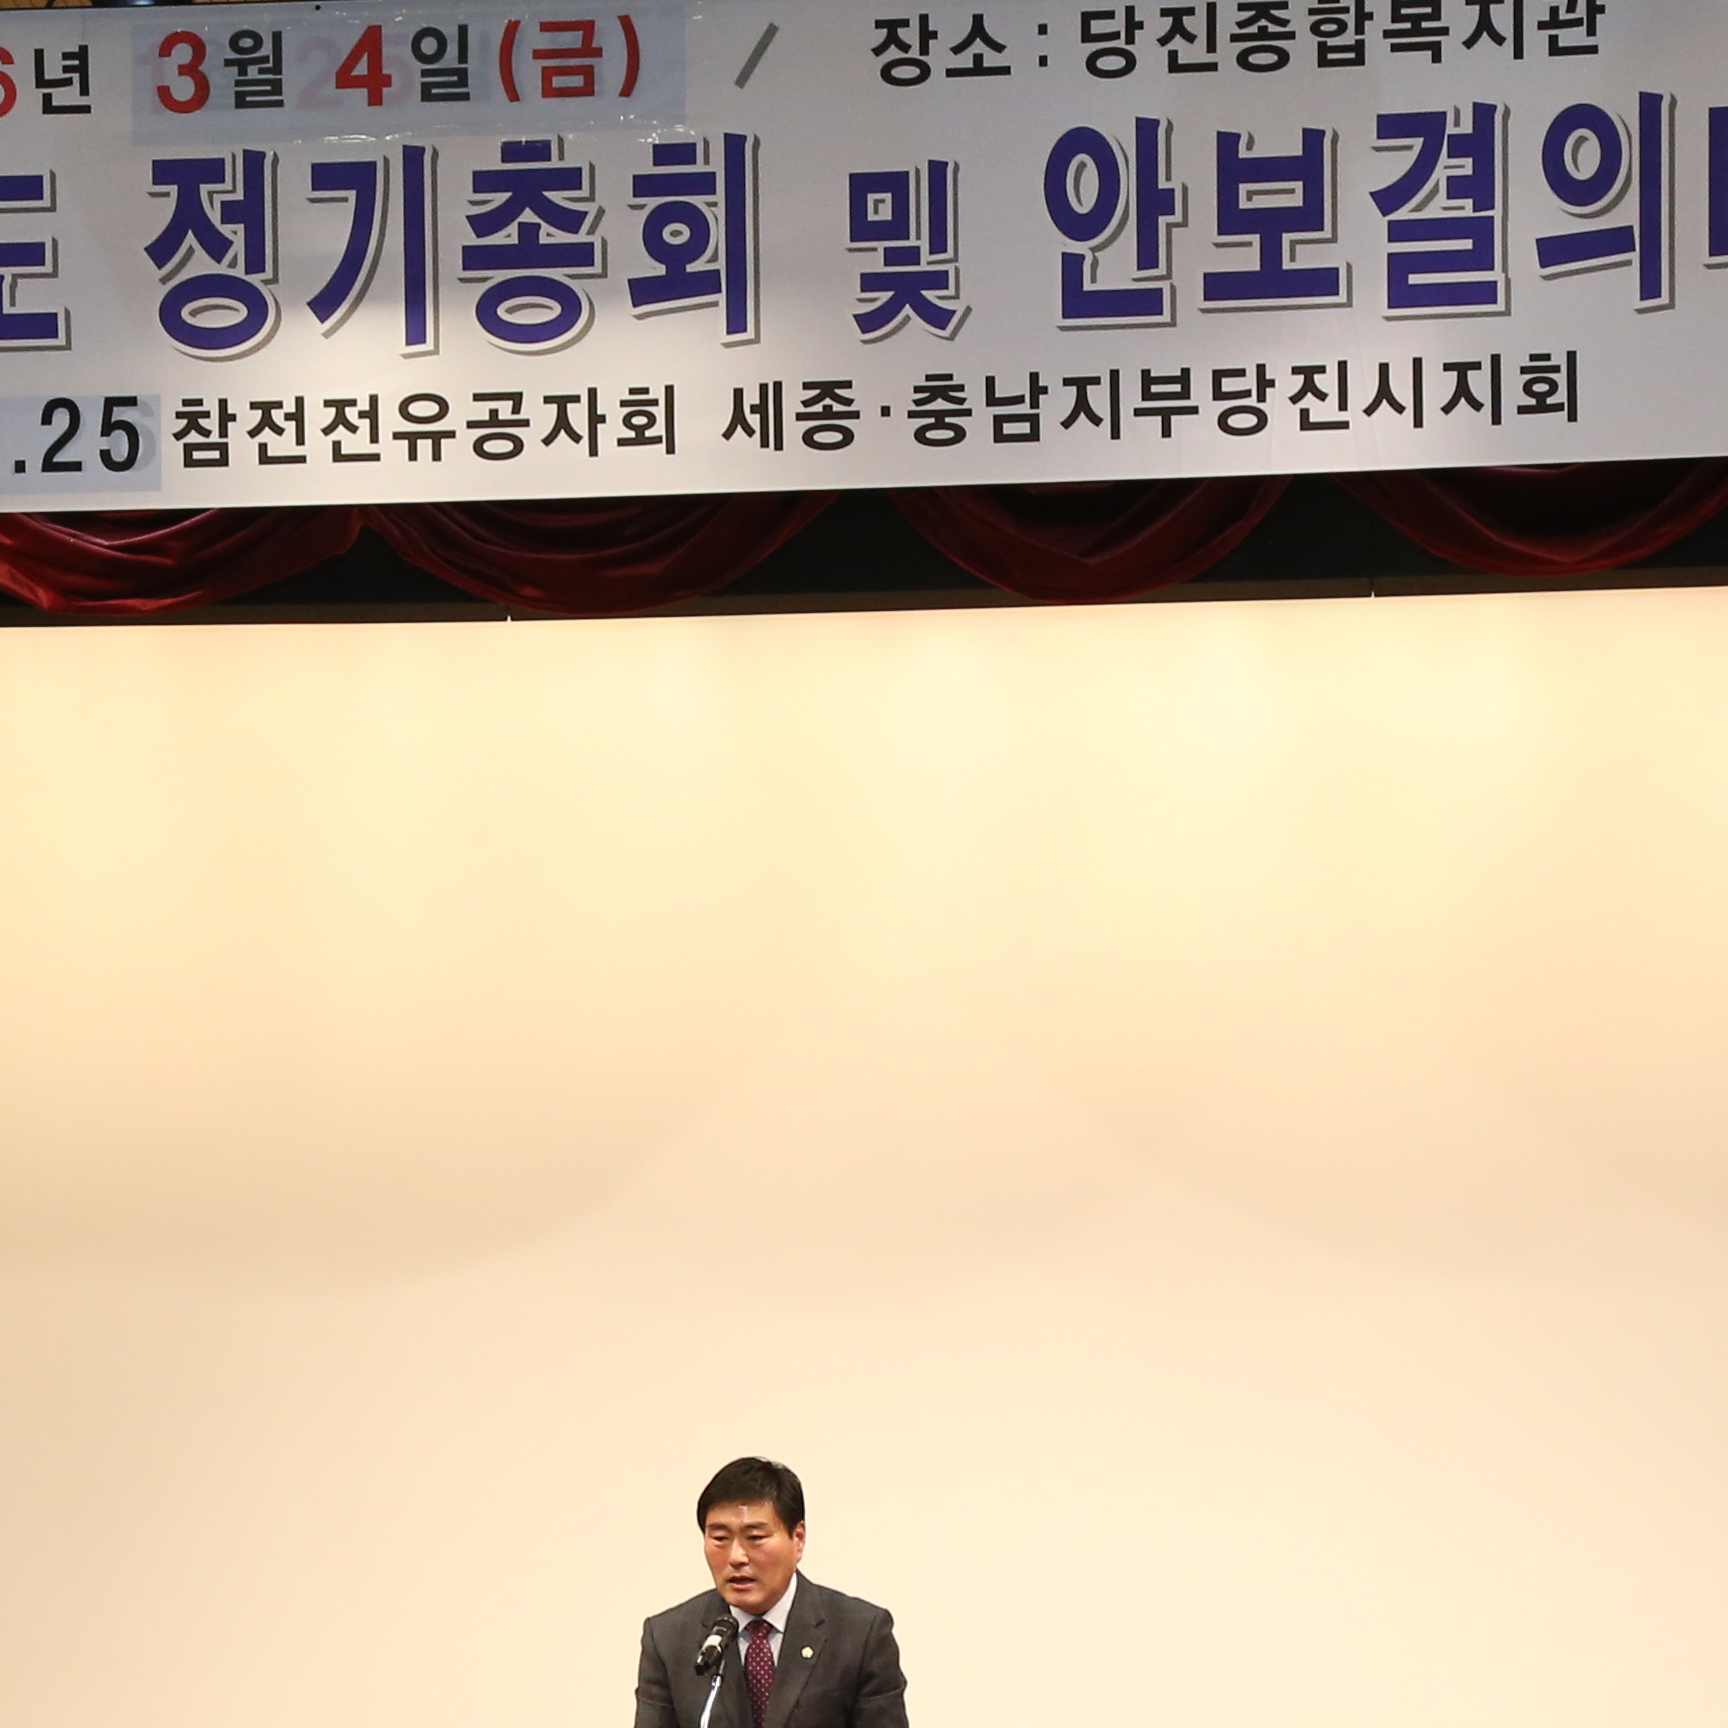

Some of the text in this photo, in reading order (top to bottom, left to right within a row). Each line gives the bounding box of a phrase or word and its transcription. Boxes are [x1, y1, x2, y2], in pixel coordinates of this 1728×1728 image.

[154, 28, 286, 115] 3월
[1078, 0, 1607, 80] 당진종합복지관
[143, 131, 762, 363] 정기총회
[845, 156, 974, 345] 및
